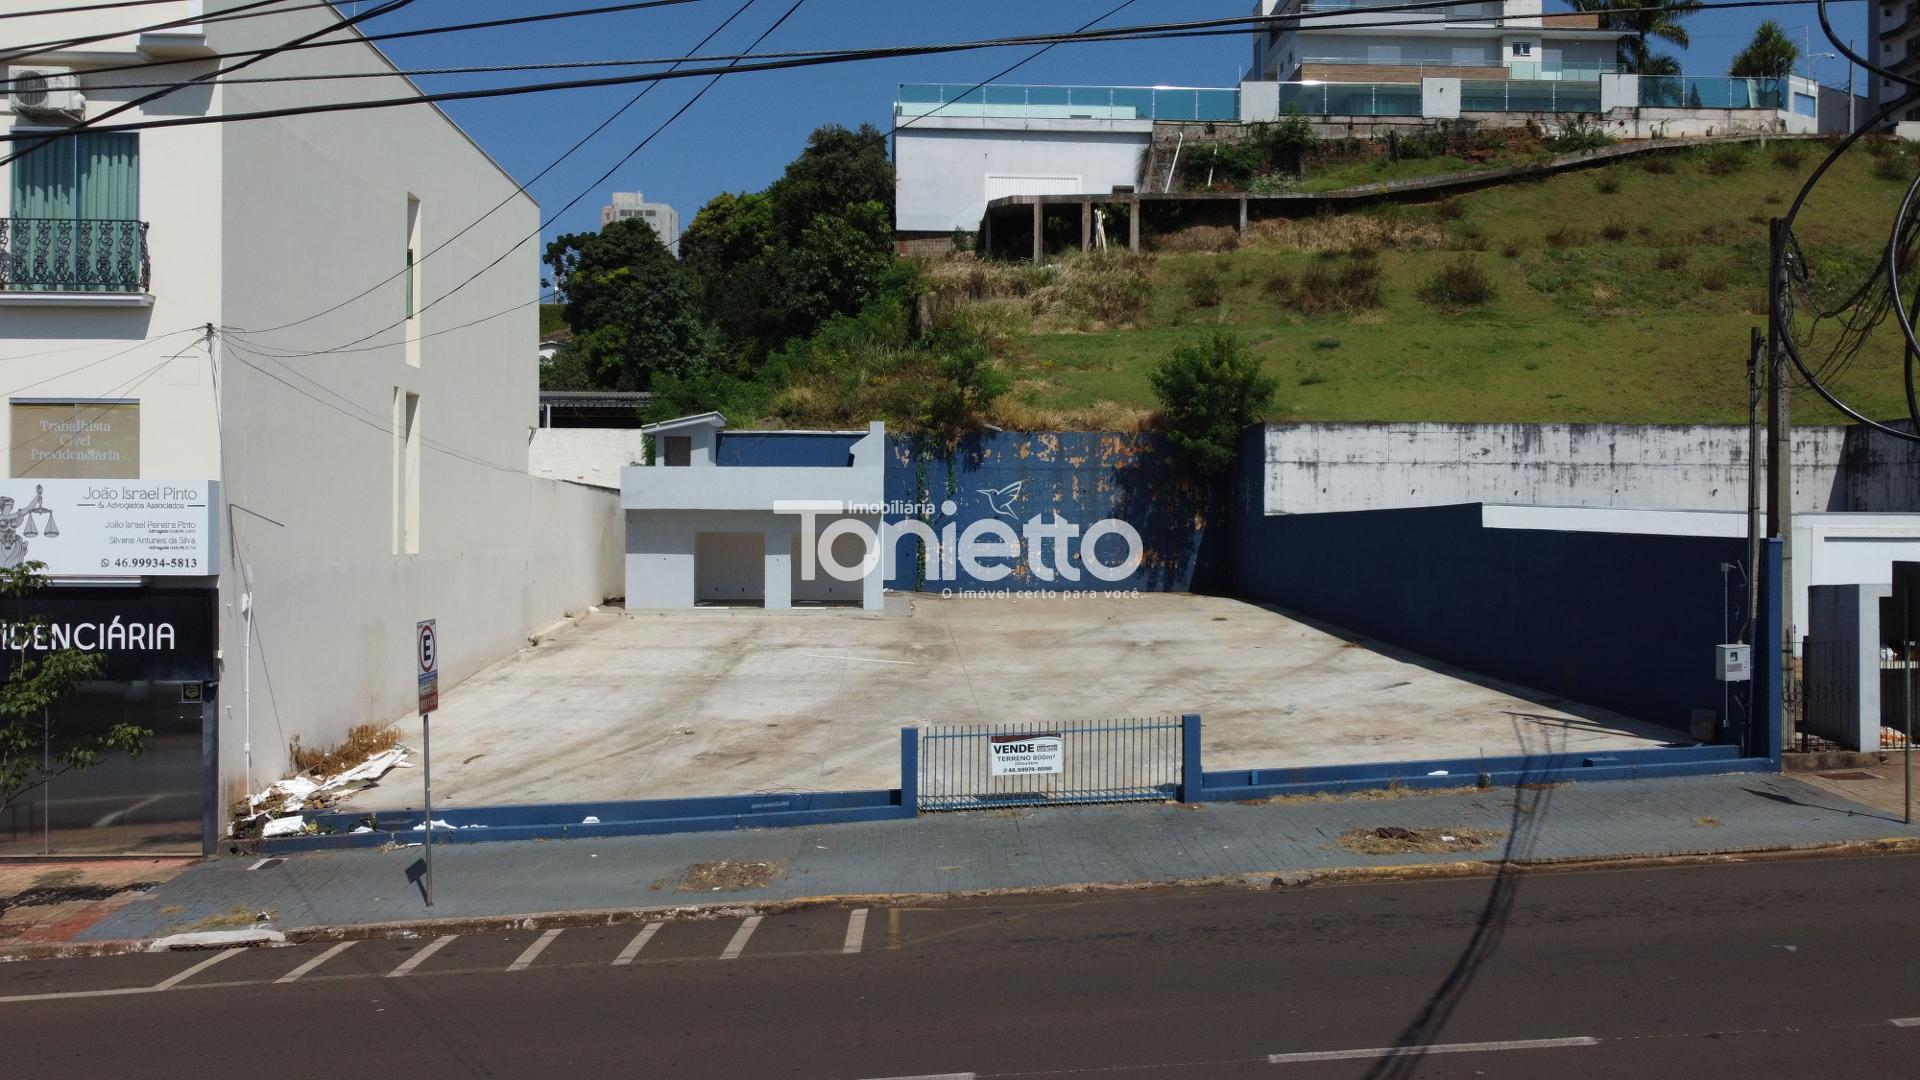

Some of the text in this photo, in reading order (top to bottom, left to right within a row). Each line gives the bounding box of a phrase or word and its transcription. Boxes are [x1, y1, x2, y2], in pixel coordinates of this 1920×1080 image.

[40, 420, 111, 432] Trabalhista
[83, 487, 198, 500] João Israel Pinto
[107, 502, 145, 510] Advogados
[105, 520, 195, 529] João Israel Pereira Pinto
[109, 536, 134, 544] Silvana
[136, 536, 166, 544] Antunes
[179, 536, 195, 544] Silva
[115, 558, 197, 568] 46.99934-5813
[423, 635, 431, 661] E
[994, 744, 1035, 754] VENDE
